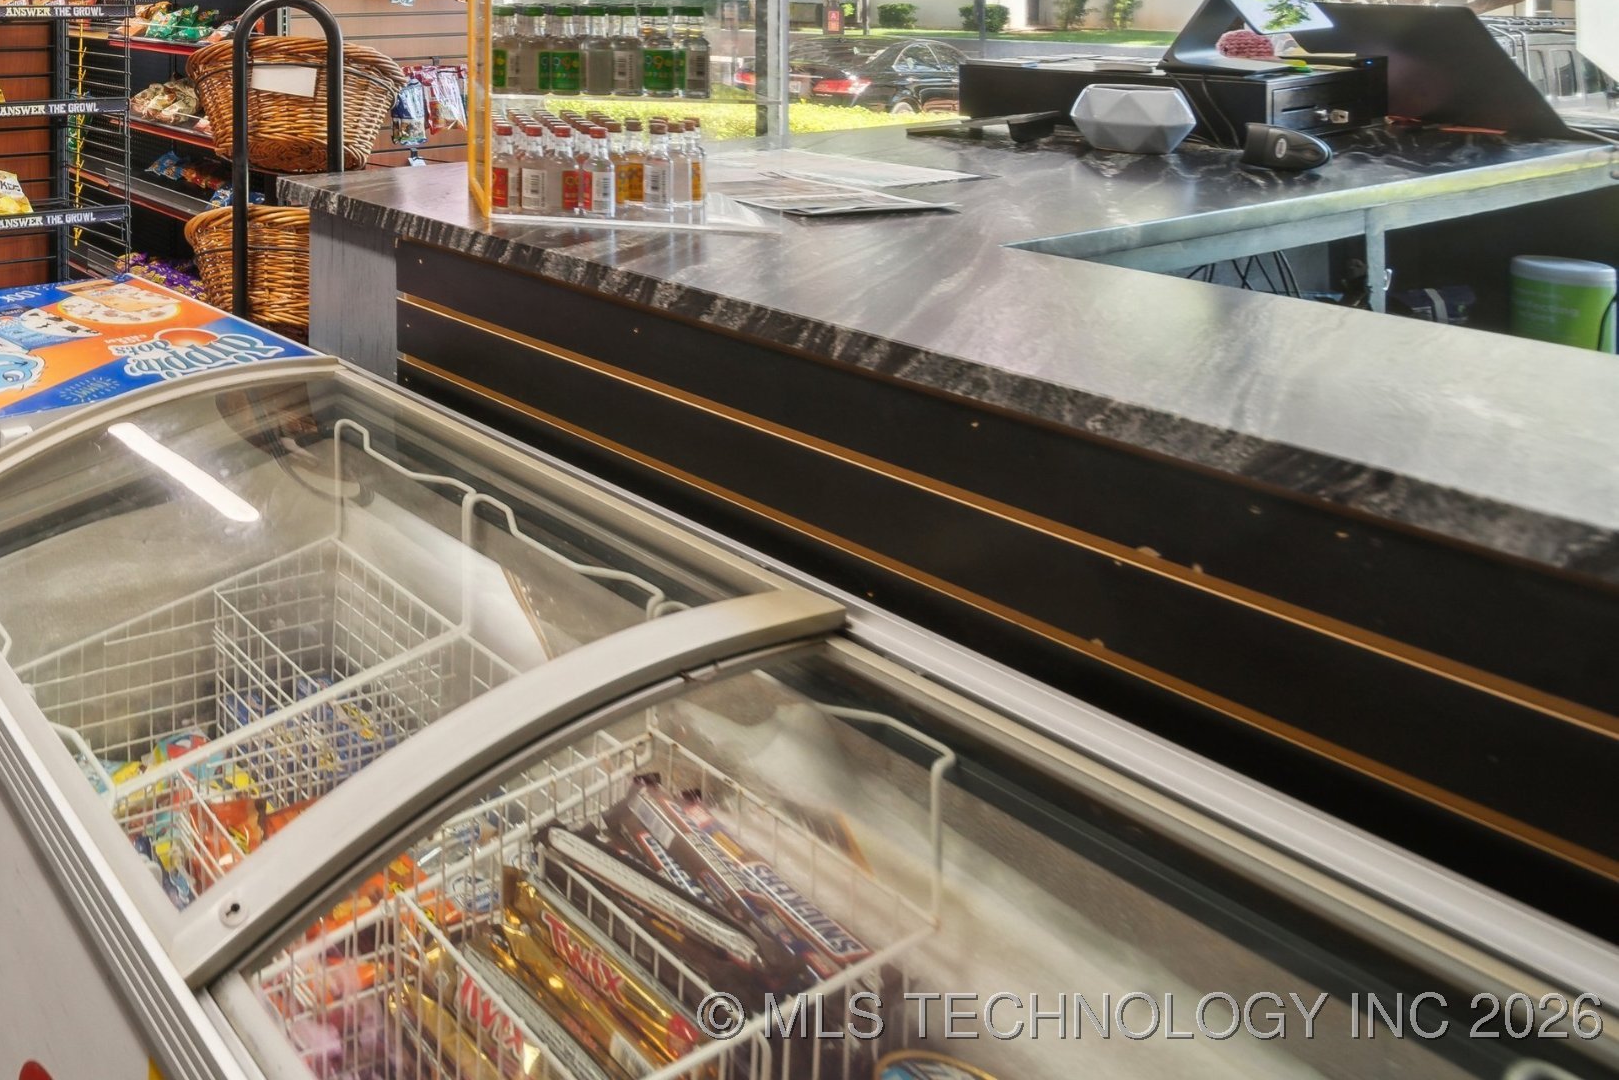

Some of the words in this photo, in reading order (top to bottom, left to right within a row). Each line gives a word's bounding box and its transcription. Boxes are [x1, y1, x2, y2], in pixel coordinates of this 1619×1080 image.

[5, 7, 51, 17] ANSWER
[54, 7, 71, 17] THE
[73, 6, 104, 16] GROWL
[0, 105, 45, 116] ANSWER
[49, 104, 66, 114] THE
[68, 102, 99, 113] GROWL
[46, 215, 63, 225] THE
[65, 212, 96, 223] GROWL
[0, 289, 41, 303] LOOK
[114, 340, 170, 357] dots
[745, 864, 855, 954] SNICKERS
